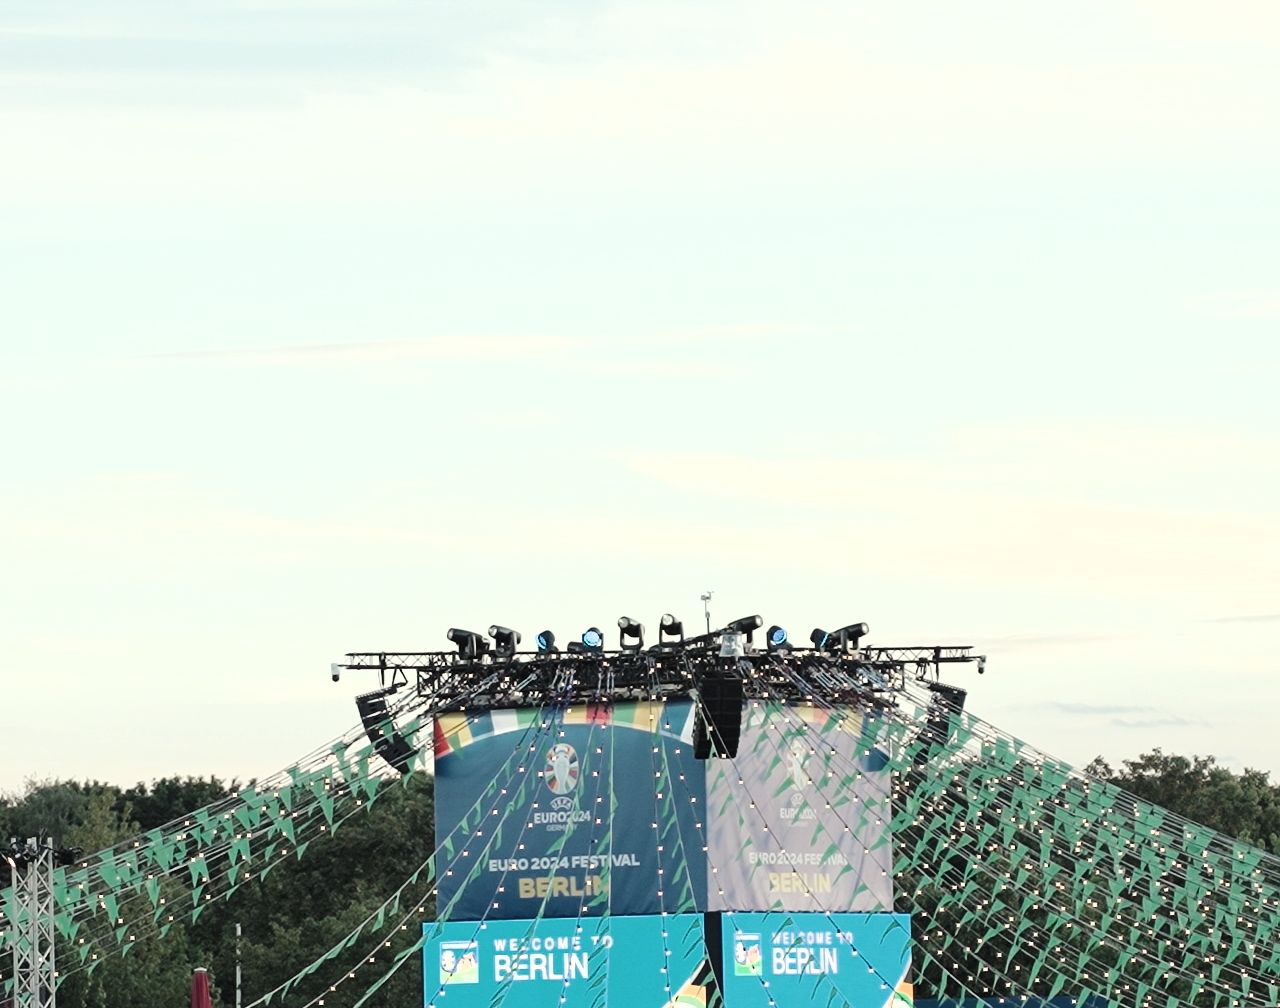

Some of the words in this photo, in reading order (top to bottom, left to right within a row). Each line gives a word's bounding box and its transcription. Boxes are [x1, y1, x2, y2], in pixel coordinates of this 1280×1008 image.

[488, 859, 529, 872] EURO
[531, 856, 569, 869] 2024
[571, 853, 640, 868] FESTVAL
[776, 853, 803, 865] 2024
[518, 876, 610, 899] BERLIN
[769, 872, 831, 893] BERLIN
[590, 935, 614, 949] TO
[494, 951, 589, 982] BERLIN
[772, 947, 838, 975] BERLIN
